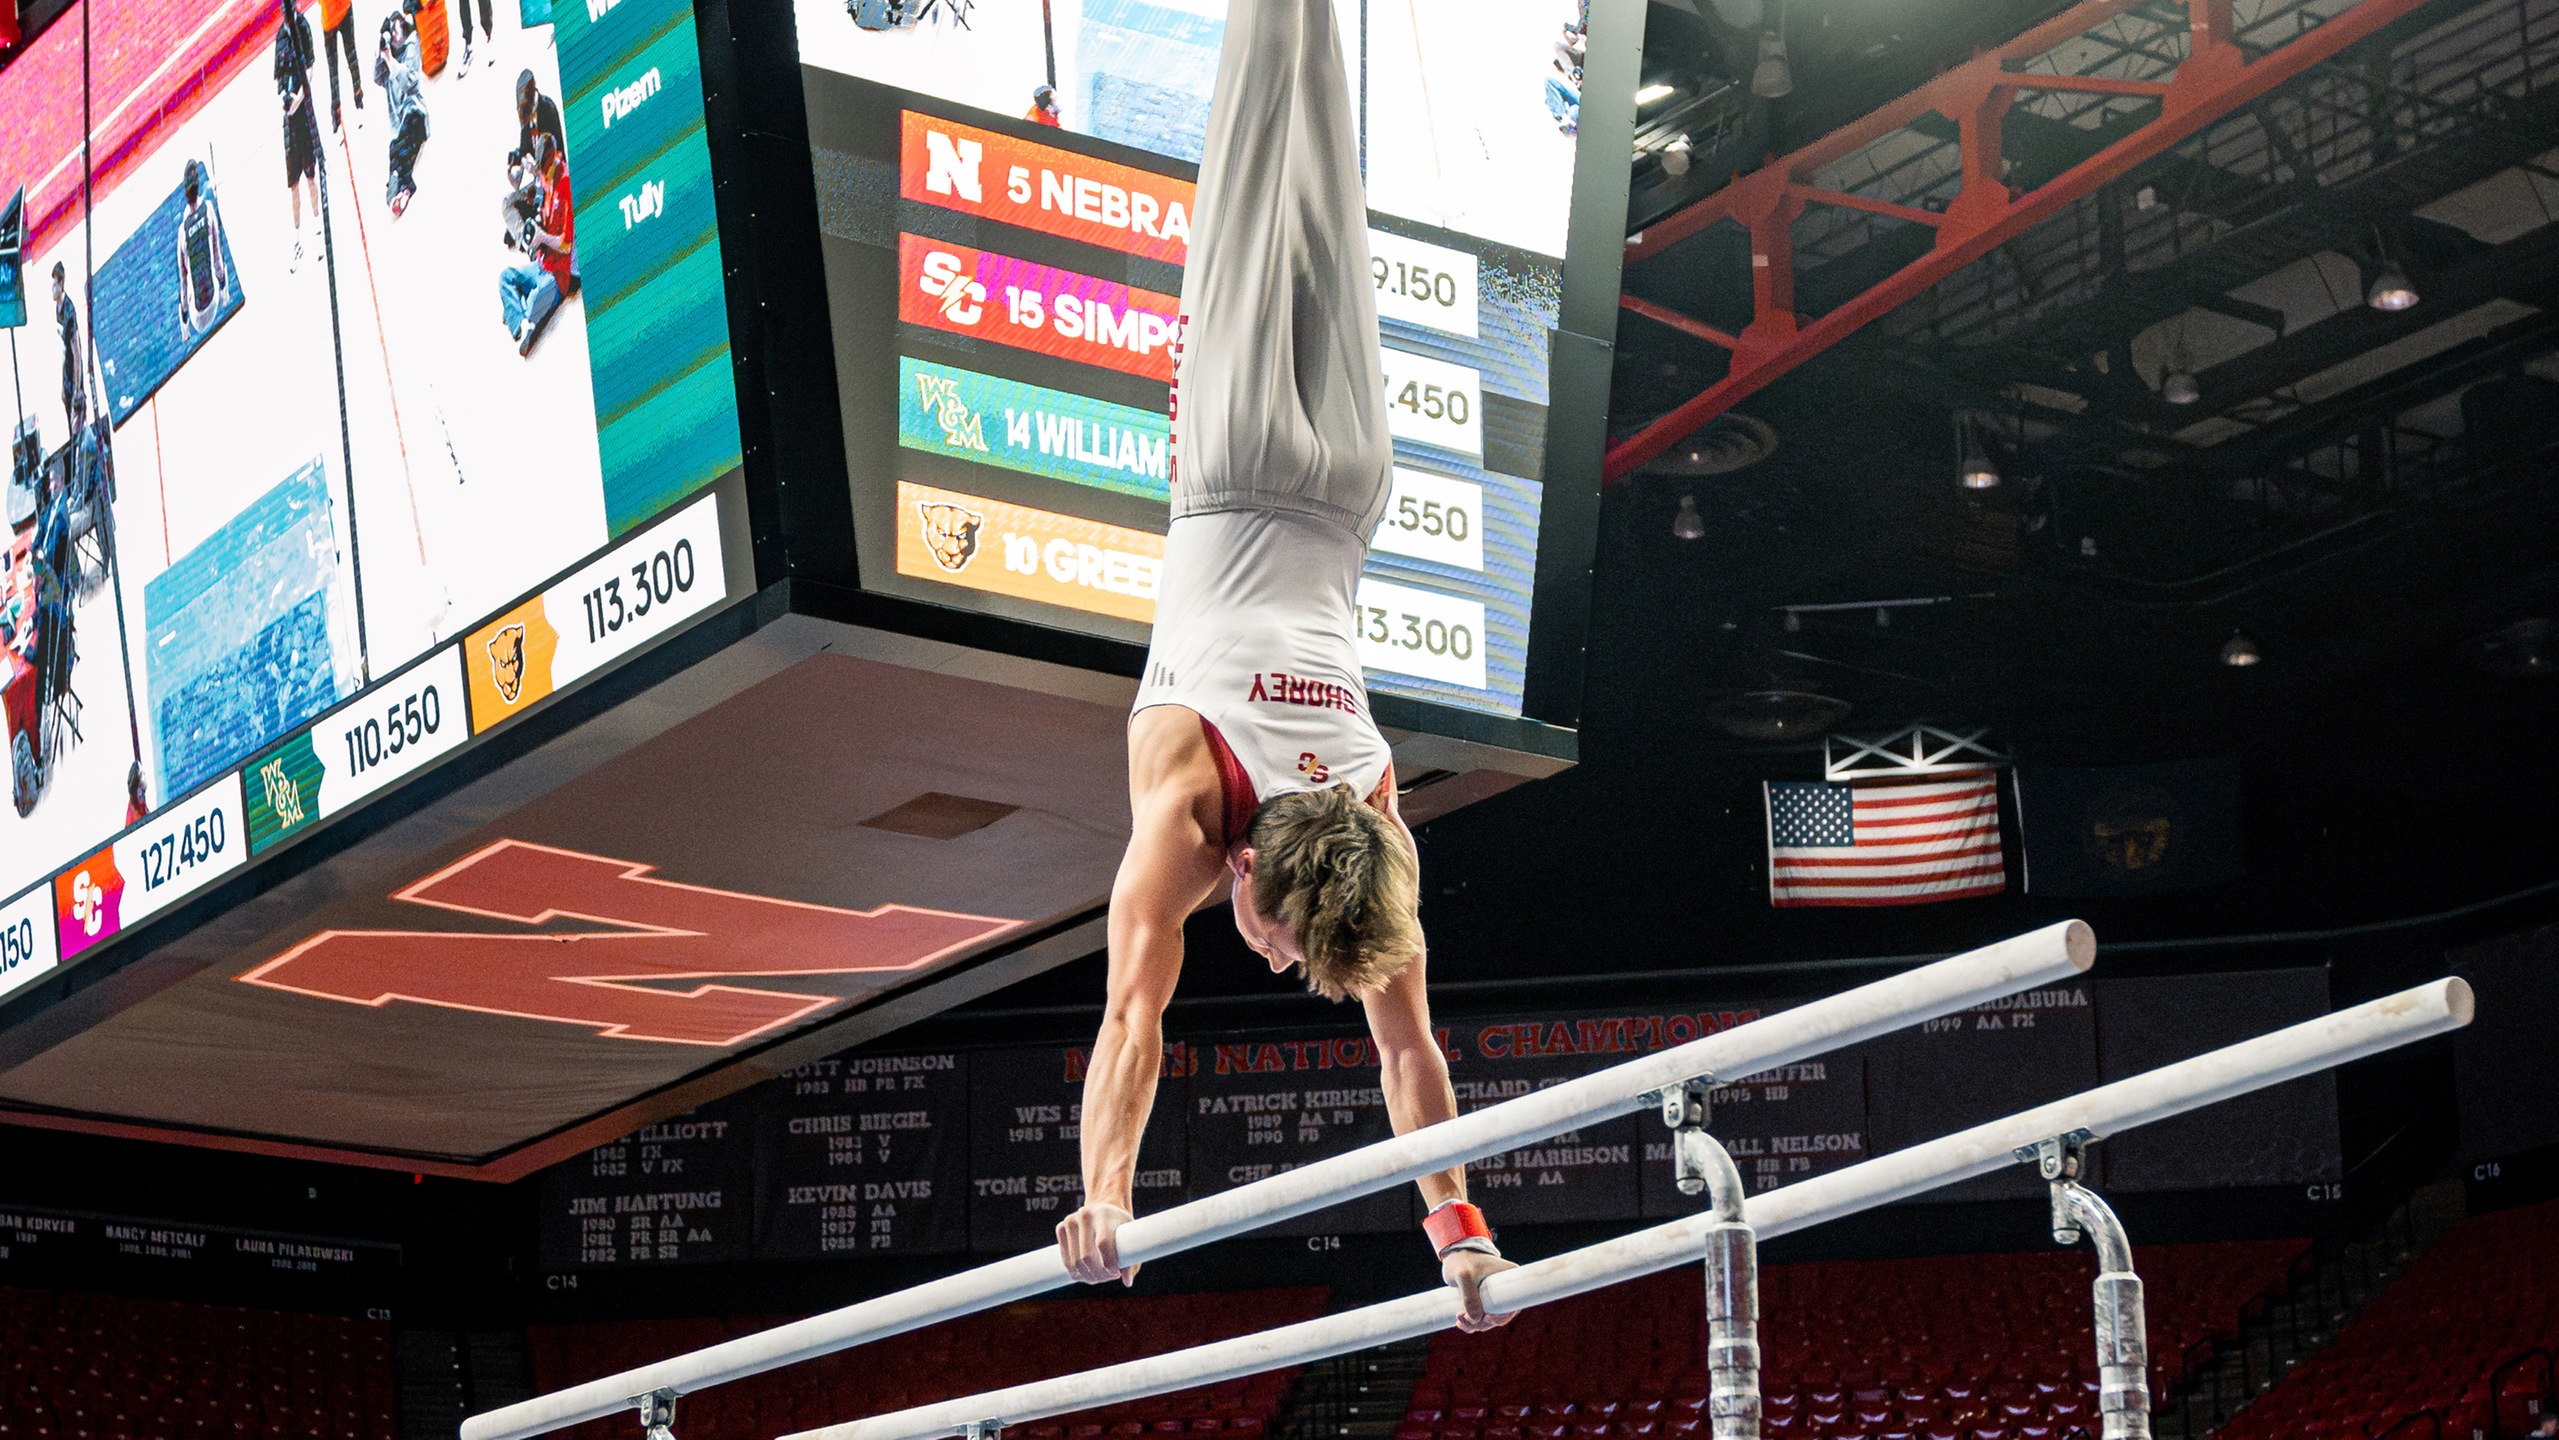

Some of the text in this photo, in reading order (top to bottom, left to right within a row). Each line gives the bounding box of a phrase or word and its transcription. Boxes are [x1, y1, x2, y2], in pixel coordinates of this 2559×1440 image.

[601, 67, 661, 129] Pizem
[925, 129, 983, 204] N
[619, 179, 664, 230] Tully
[1007, 166, 1191, 246] 5 NEBRA
[1372, 256, 1456, 307] 9.150
[1005, 285, 1045, 330] 15
[1004, 408, 1166, 480] 14 WILLIAM
[1380, 495, 1468, 541] .550
[1002, 531, 1038, 577] 10
[583, 538, 693, 645] 113.300
[1356, 605, 1472, 660] 13.300
[1248, 672, 1358, 715] SHOREY
[345, 684, 441, 778] 110.550
[140, 807, 226, 892] 127.450
[850, 1054, 955, 1075] JOHNSON
[1015, 1105, 1062, 1124] WES
[1199, 1092, 1298, 1115] PATRICK
[640, 1121, 728, 1143] ELLIOTT
[788, 1114, 852, 1135] CHRIS
[877, 1133, 891, 1148] V
[1771, 1133, 1863, 1153] NELSON
[878, 1149, 891, 1164] V
[1514, 1145, 1629, 1168] HARRISON
[788, 1180, 933, 1204] KEVIN DAVIS
[974, 1176, 1027, 1197] TOM
[569, 1190, 722, 1215] JIM HARTUNG
[236, 1238, 274, 1254] LAURA
[687, 1228, 713, 1242] AA
[1307, 1236, 1341, 1252] C14
